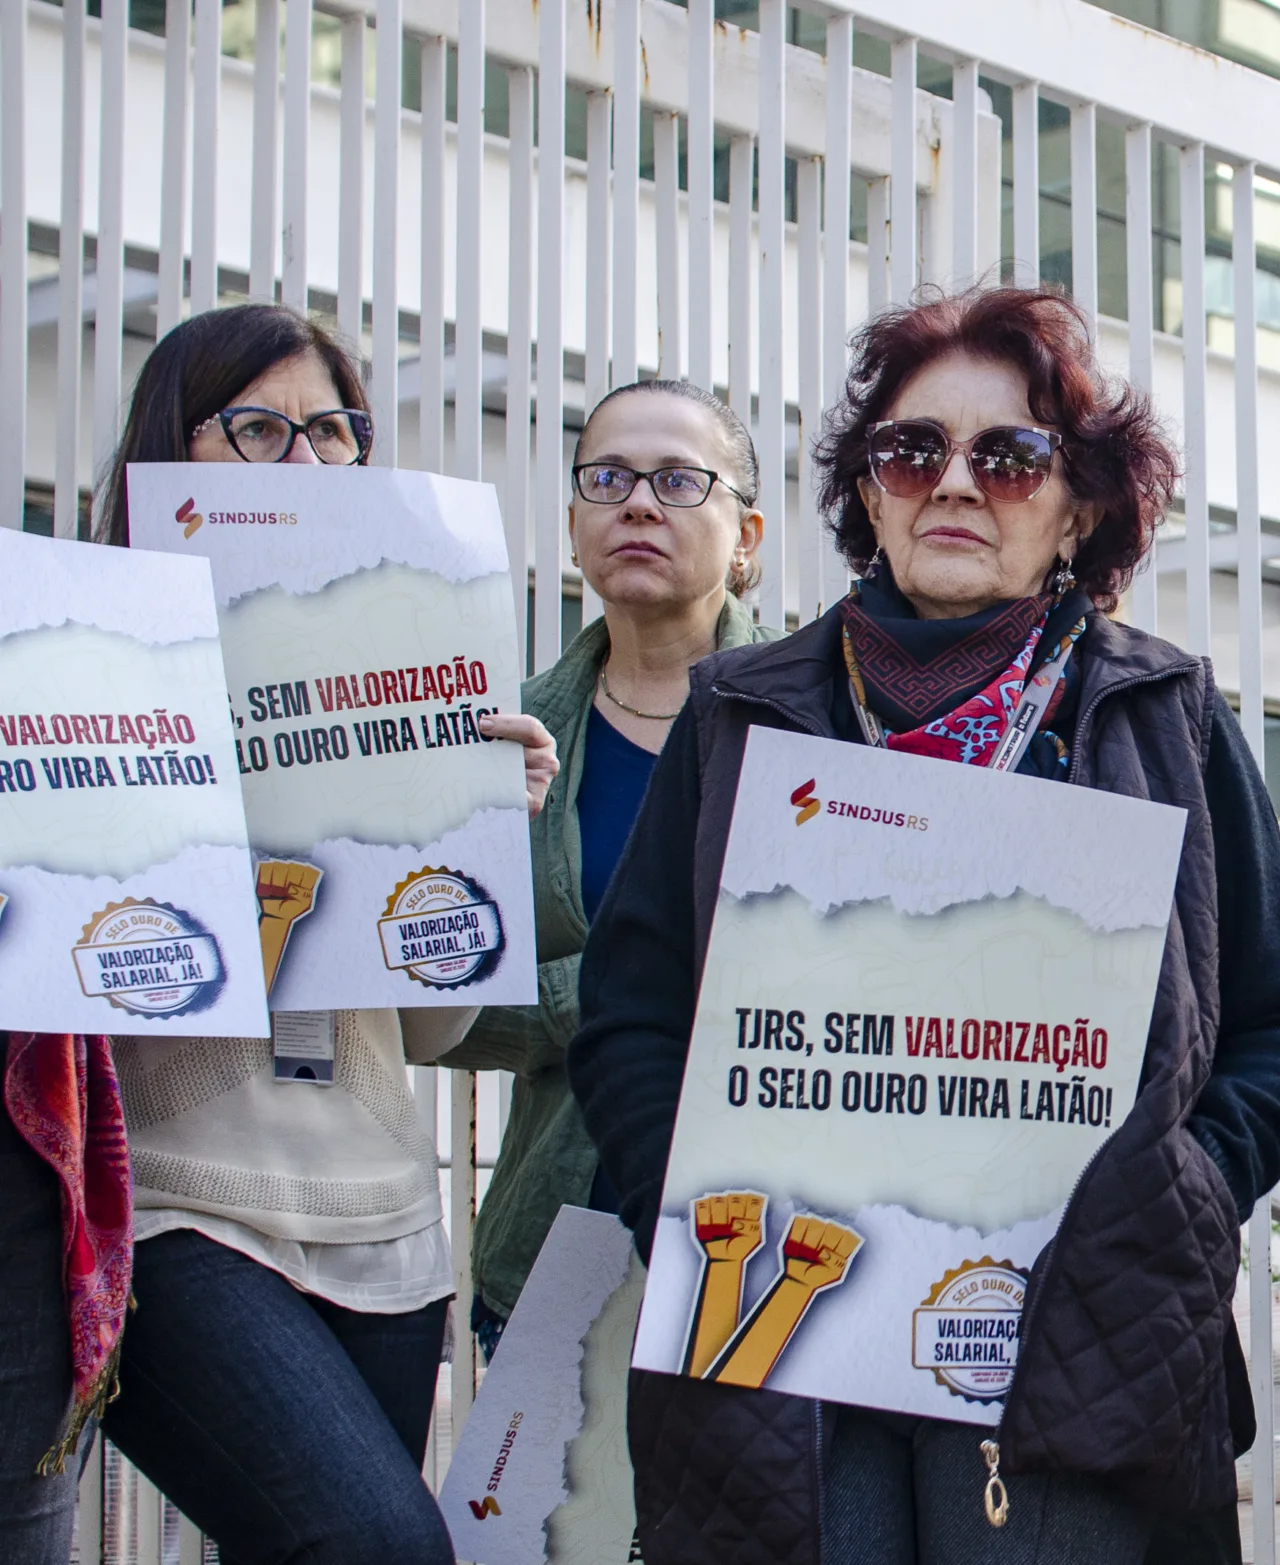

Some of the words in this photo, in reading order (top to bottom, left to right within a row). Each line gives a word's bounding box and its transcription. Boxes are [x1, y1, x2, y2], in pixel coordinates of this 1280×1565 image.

[247, 680, 312, 722] SEM
[315, 655, 489, 713] VALORIZAÇÃO
[0, 708, 196, 750] VALORIZAÇÃO
[235, 735, 269, 774] LO
[273, 724, 350, 768] OURO
[353, 716, 419, 757] VIRA
[0, 758, 37, 793] RO
[40, 756, 117, 789] VIRA
[118, 750, 218, 786] LATÃO!
[406, 888, 426, 910] SELO
[427, 884, 453, 895] OURO
[455, 889, 468, 903] DE
[105, 919, 129, 940] SELO
[130, 915, 162, 926] OURO
[163, 921, 180, 935] DE
[399, 910, 480, 941] VALORIZAÇÃO
[97, 942, 194, 969] VALORIZAÇÃO
[401, 936, 466, 961] SALARIAL,
[468, 929, 487, 950] JÁ!
[100, 967, 178, 989] SALARIAL,
[181, 960, 204, 981] JÁ!
[736, 1007, 814, 1057] TJRS,
[824, 1011, 895, 1056] SEM
[905, 1017, 1109, 1073] VALORIZAÇÃO
[728, 1065, 748, 1107] O
[758, 1066, 832, 1111] SELO
[841, 1070, 928, 1115] OURO
[938, 1075, 1010, 1119] VIRA
[1020, 1075, 1113, 1128] LATÃO!
[952, 1281, 979, 1304] SELO
[981, 1278, 1013, 1294] OURO
[938, 1316, 1022, 1343] VALORIZAÇ
[934, 1342, 1011, 1364] SALARIAL,
